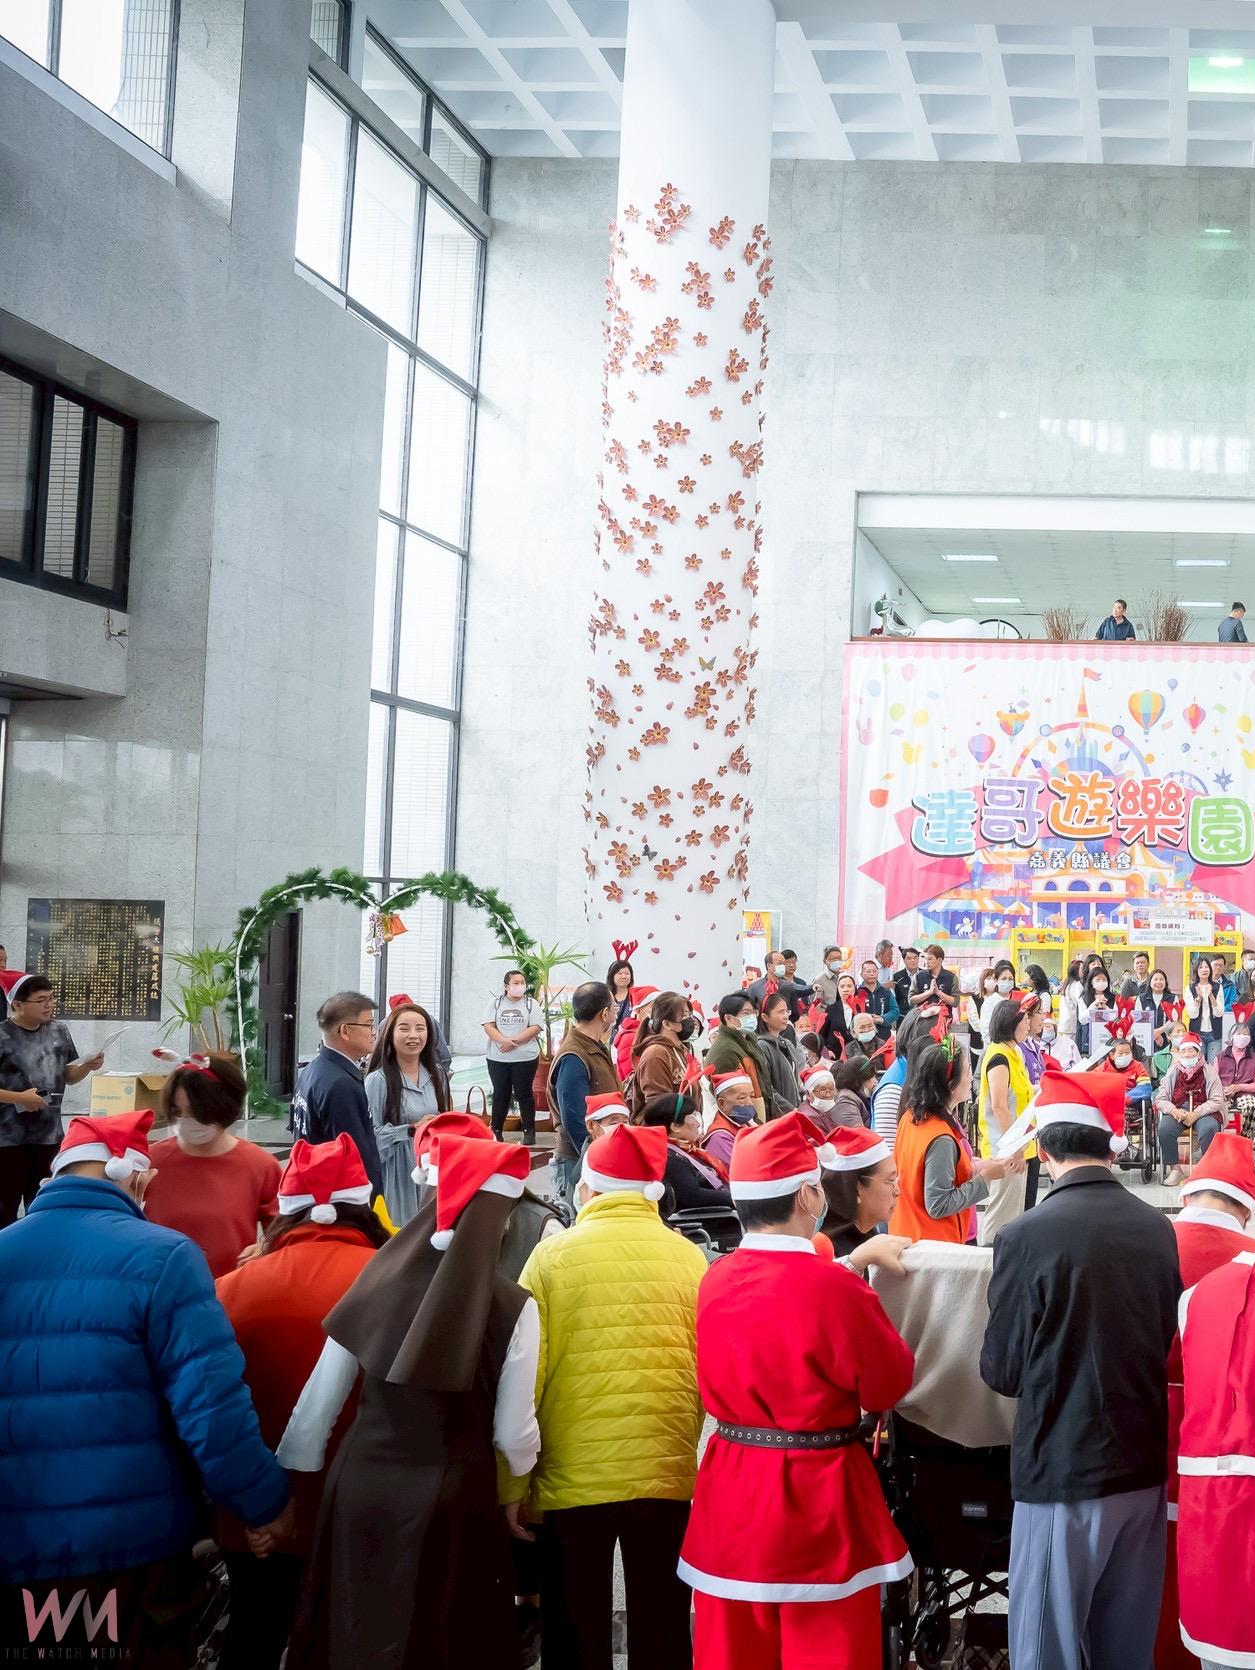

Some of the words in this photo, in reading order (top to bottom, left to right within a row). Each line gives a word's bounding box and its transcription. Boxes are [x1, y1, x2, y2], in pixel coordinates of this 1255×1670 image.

[1028, 850, 1132, 870] 嘉義縣議會
